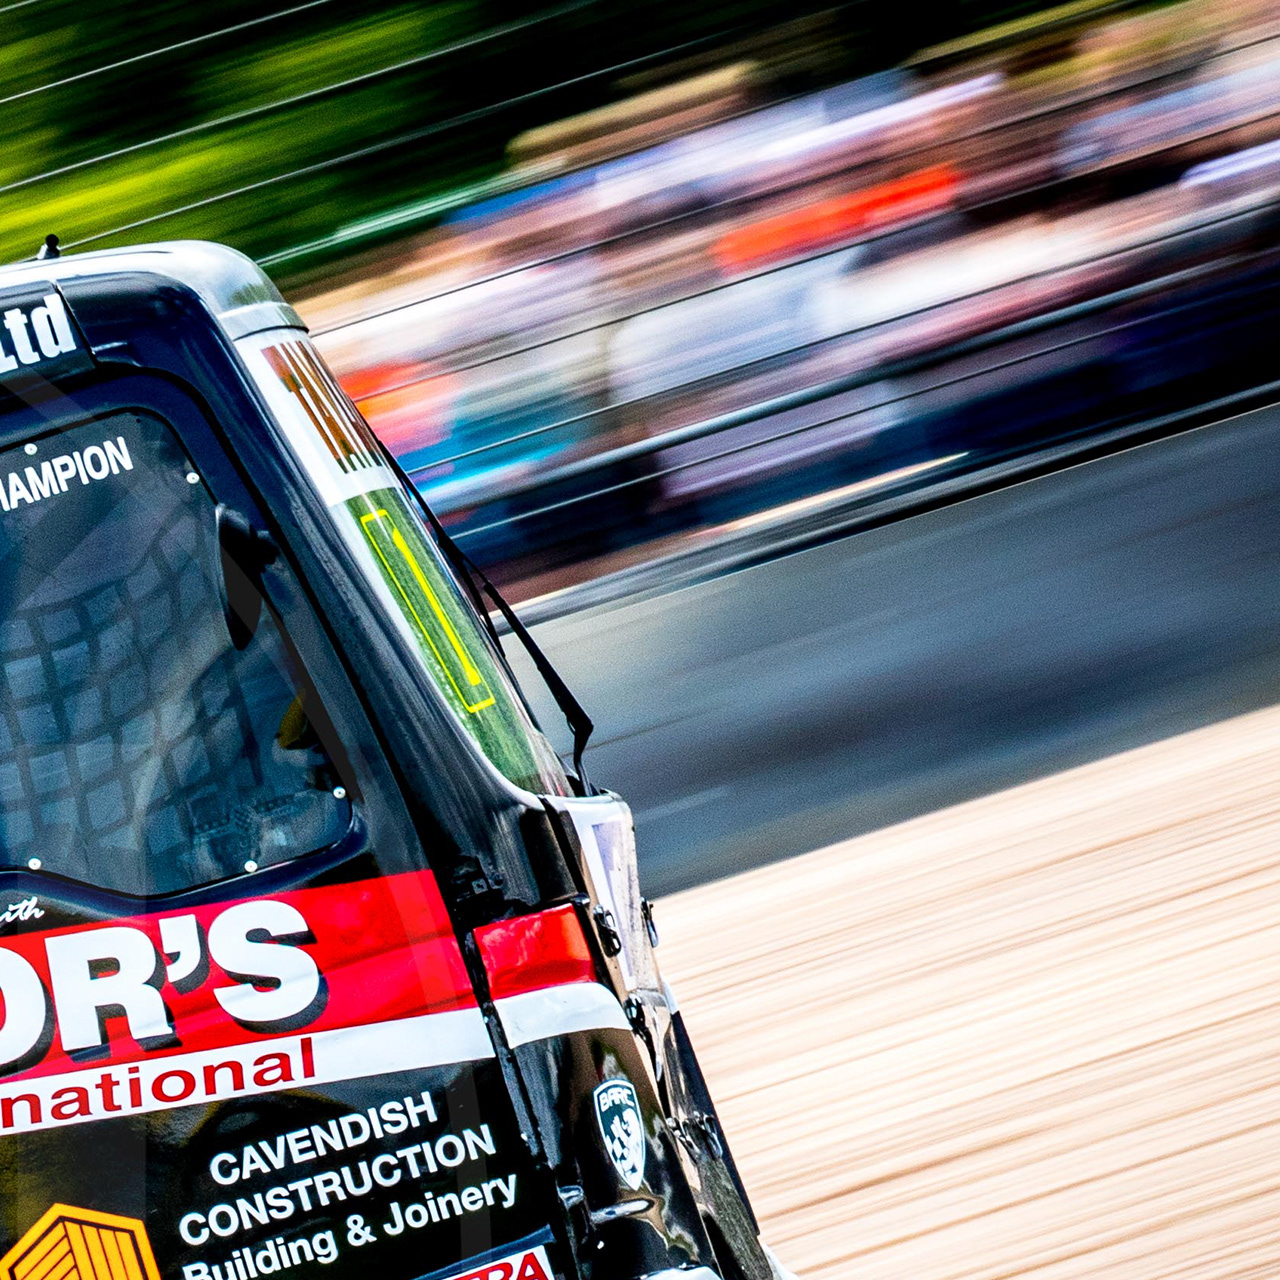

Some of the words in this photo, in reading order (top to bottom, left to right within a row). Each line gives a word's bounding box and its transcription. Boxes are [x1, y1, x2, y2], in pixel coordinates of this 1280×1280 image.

[209, 1090, 438, 1186] CAVENDISH
[599, 1087, 635, 1112] BARC
[178, 1124, 497, 1246] CONSTRUCTION
[346, 1214, 378, 1247] &
[382, 1173, 517, 1238] Joinery
